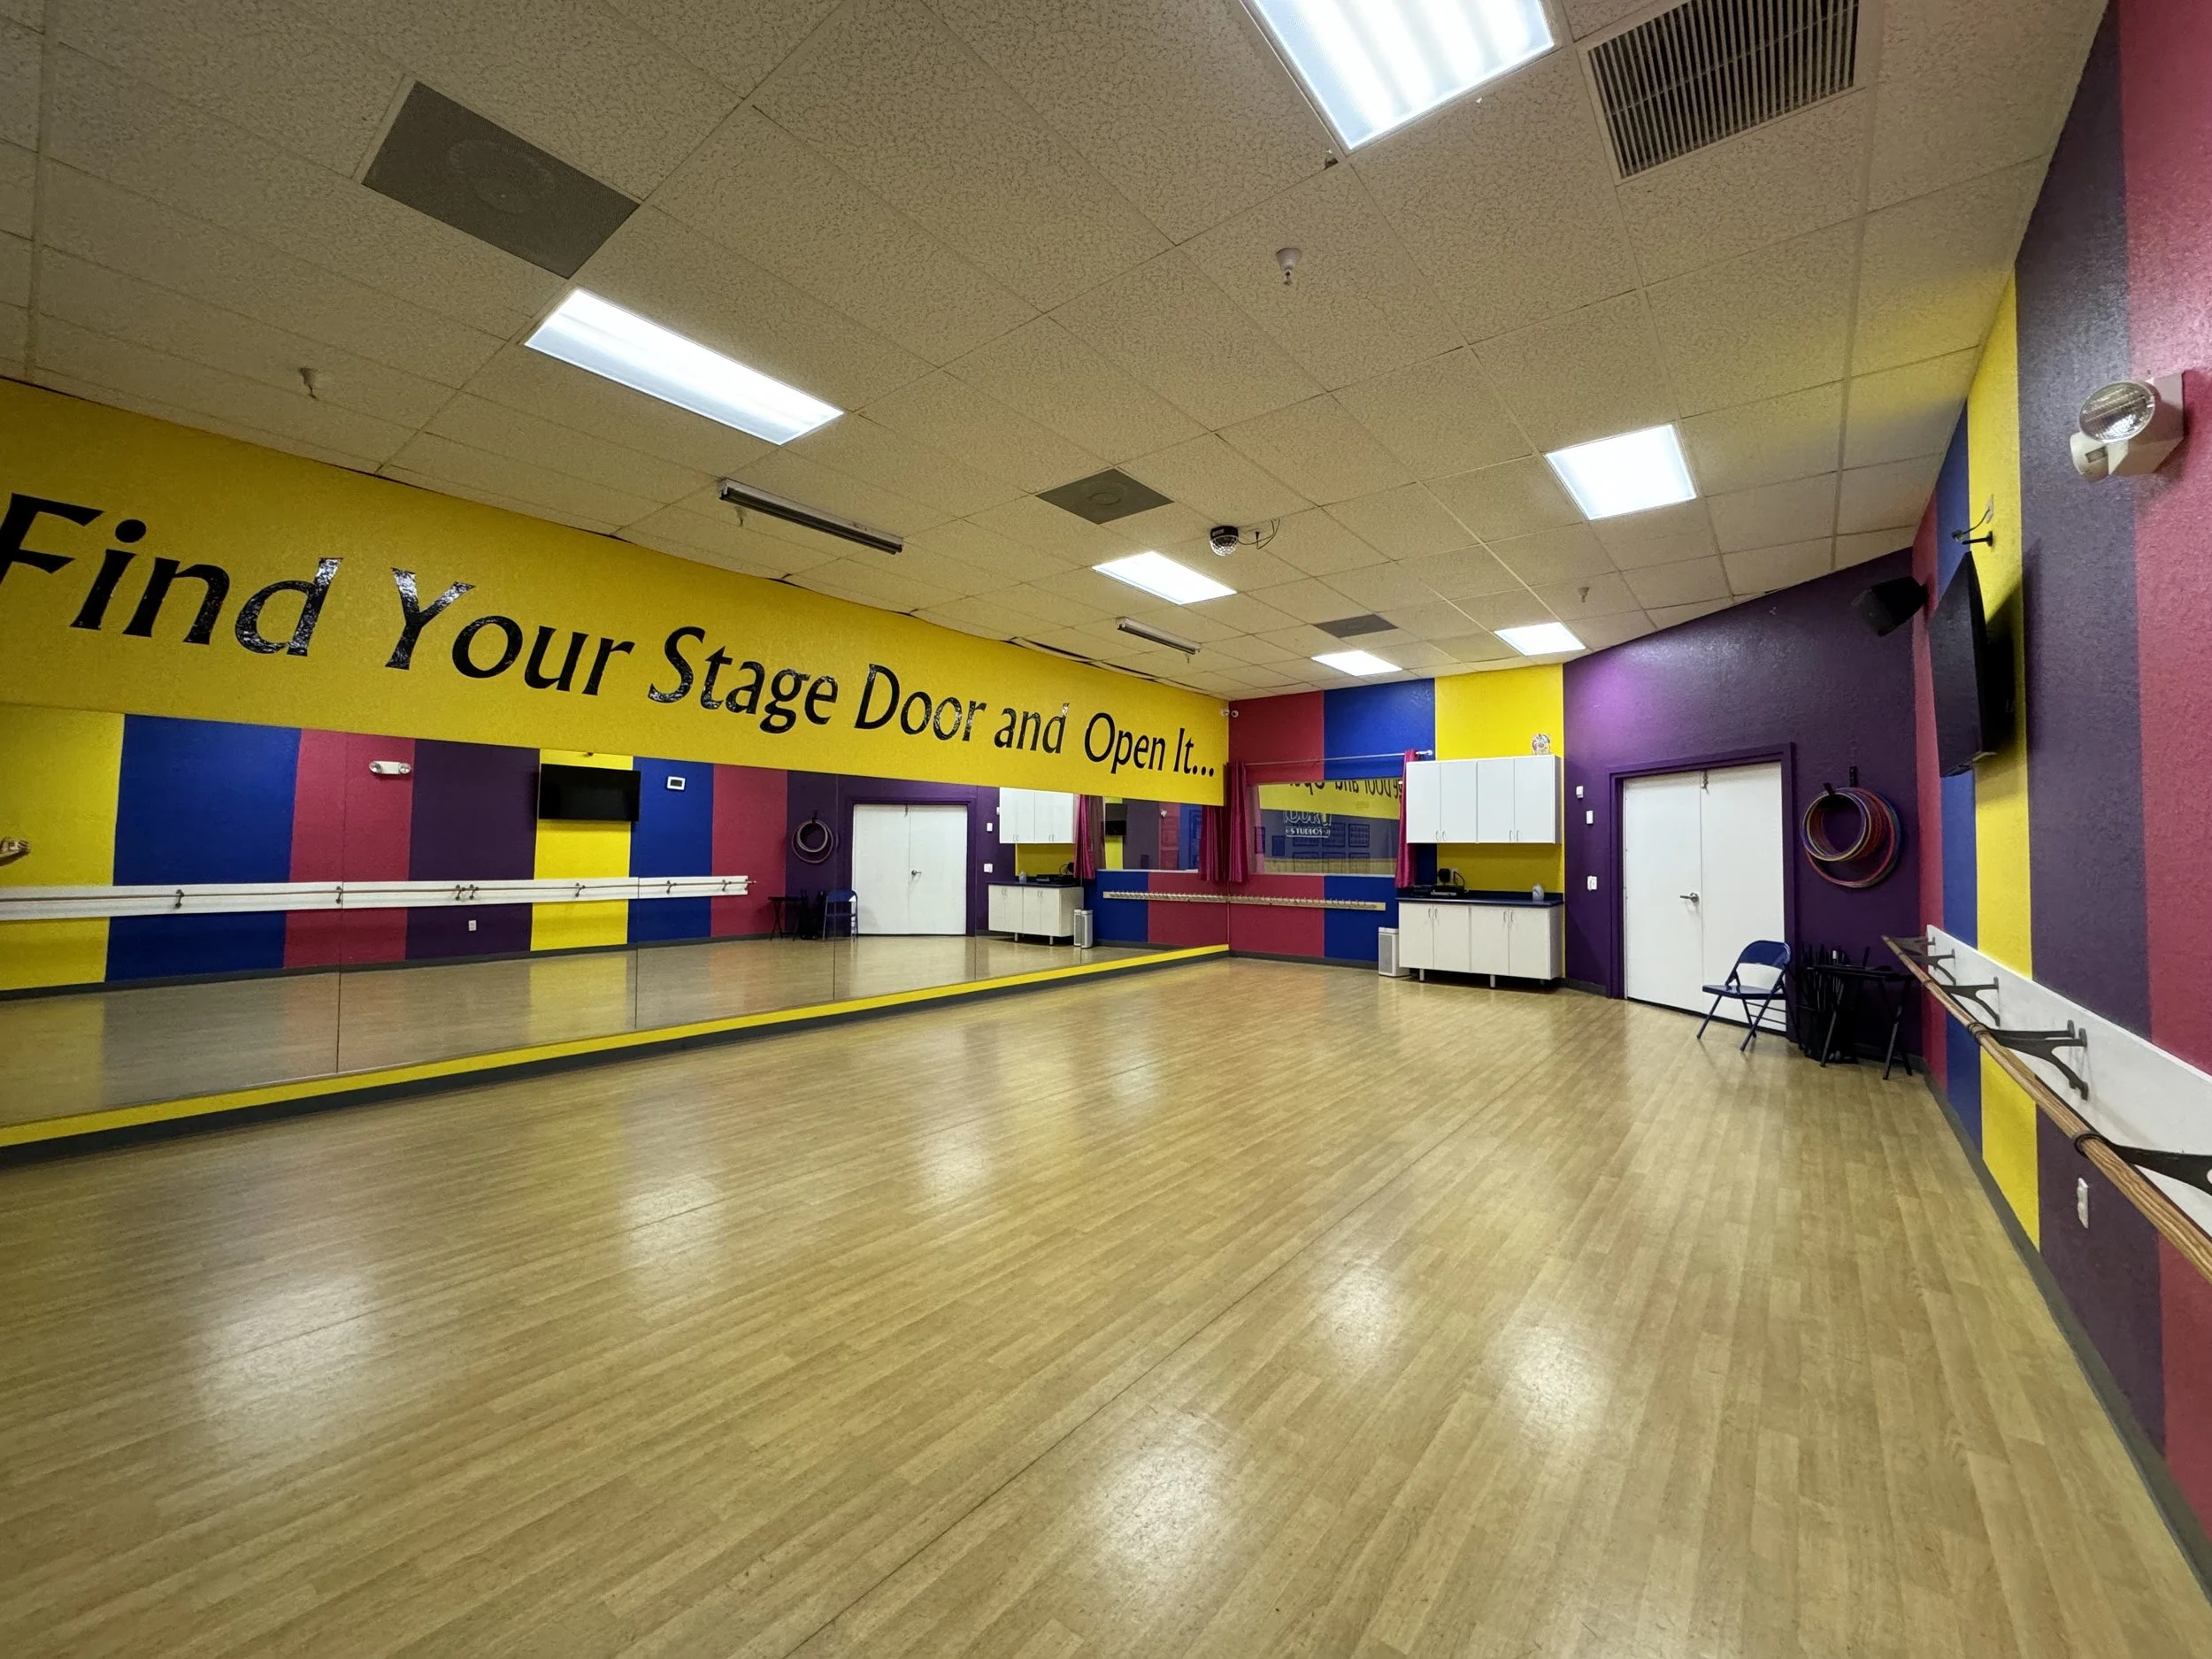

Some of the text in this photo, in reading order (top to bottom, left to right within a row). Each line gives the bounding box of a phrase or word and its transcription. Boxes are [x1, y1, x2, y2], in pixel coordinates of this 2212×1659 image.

[0, 493, 1214, 777] Find Your Stage Door and Open It...
